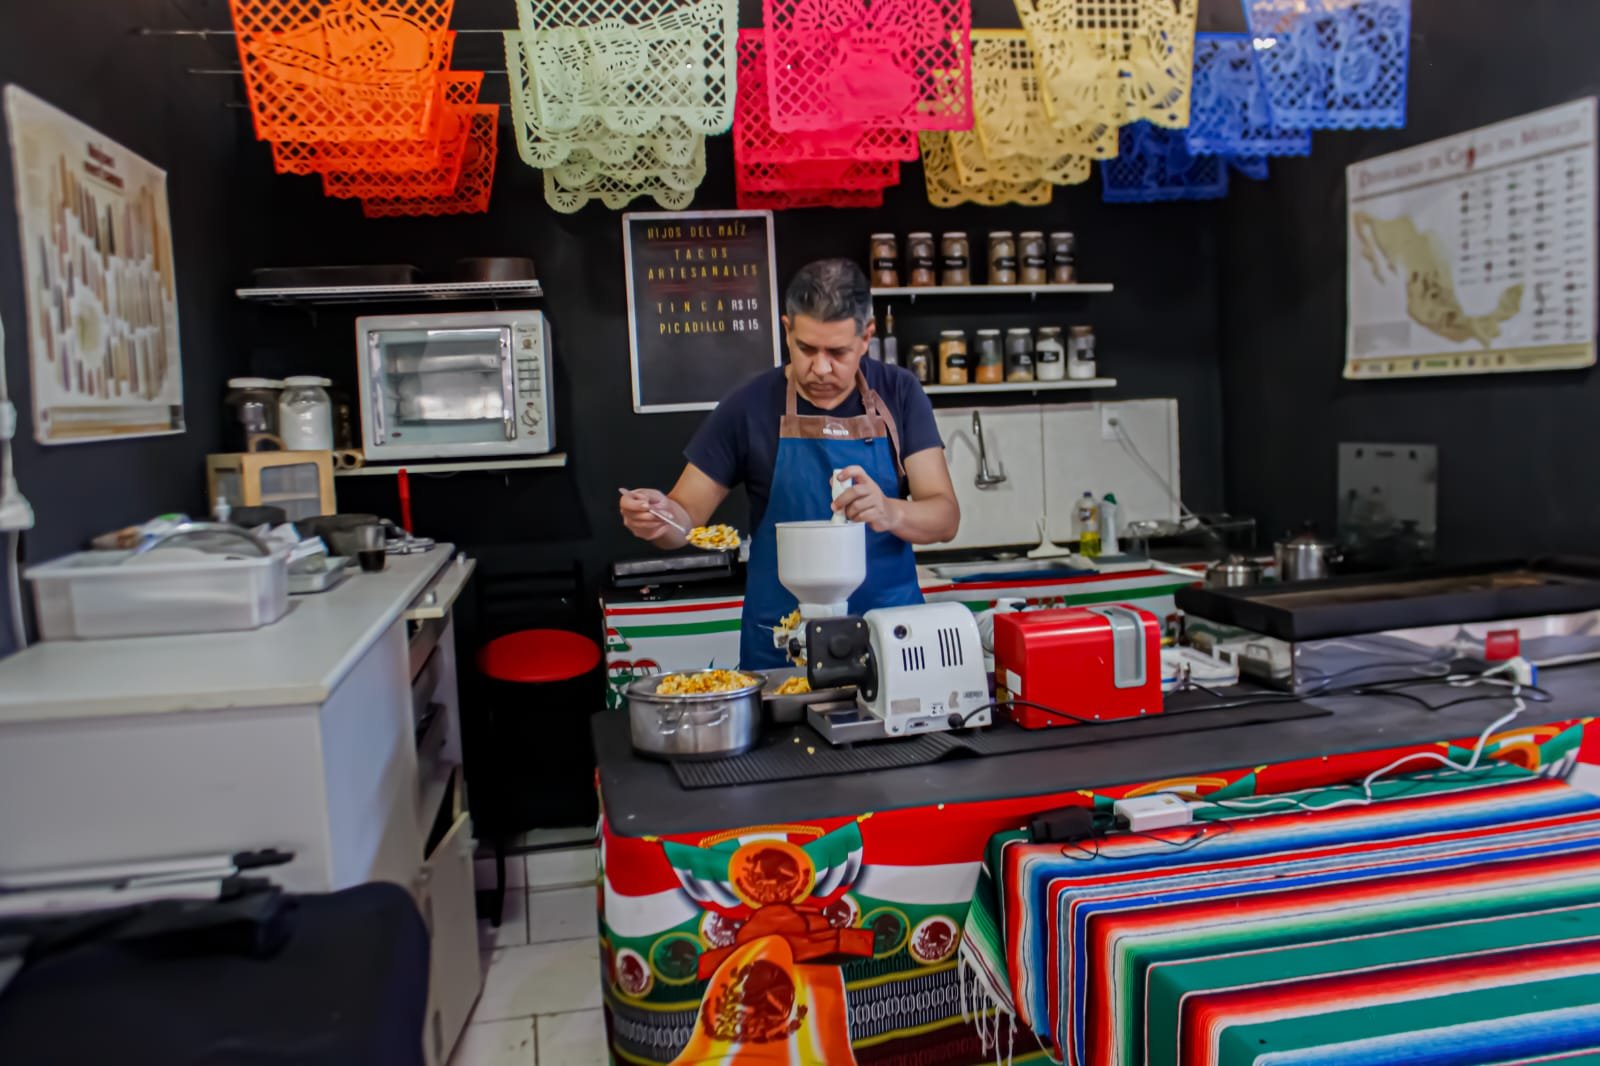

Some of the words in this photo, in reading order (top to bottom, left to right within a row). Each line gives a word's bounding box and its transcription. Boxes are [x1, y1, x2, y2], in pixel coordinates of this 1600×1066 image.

[647, 226, 681, 240] HIJOS
[690, 225, 712, 238] DEL
[718, 220, 747, 237] MAÍZ
[675, 248, 727, 261] TACOS
[648, 264, 757, 280] ARTESANALES
[747, 298, 758, 310] 15
[660, 320, 725, 335] PICADILLO
[748, 319, 759, 331] 15
